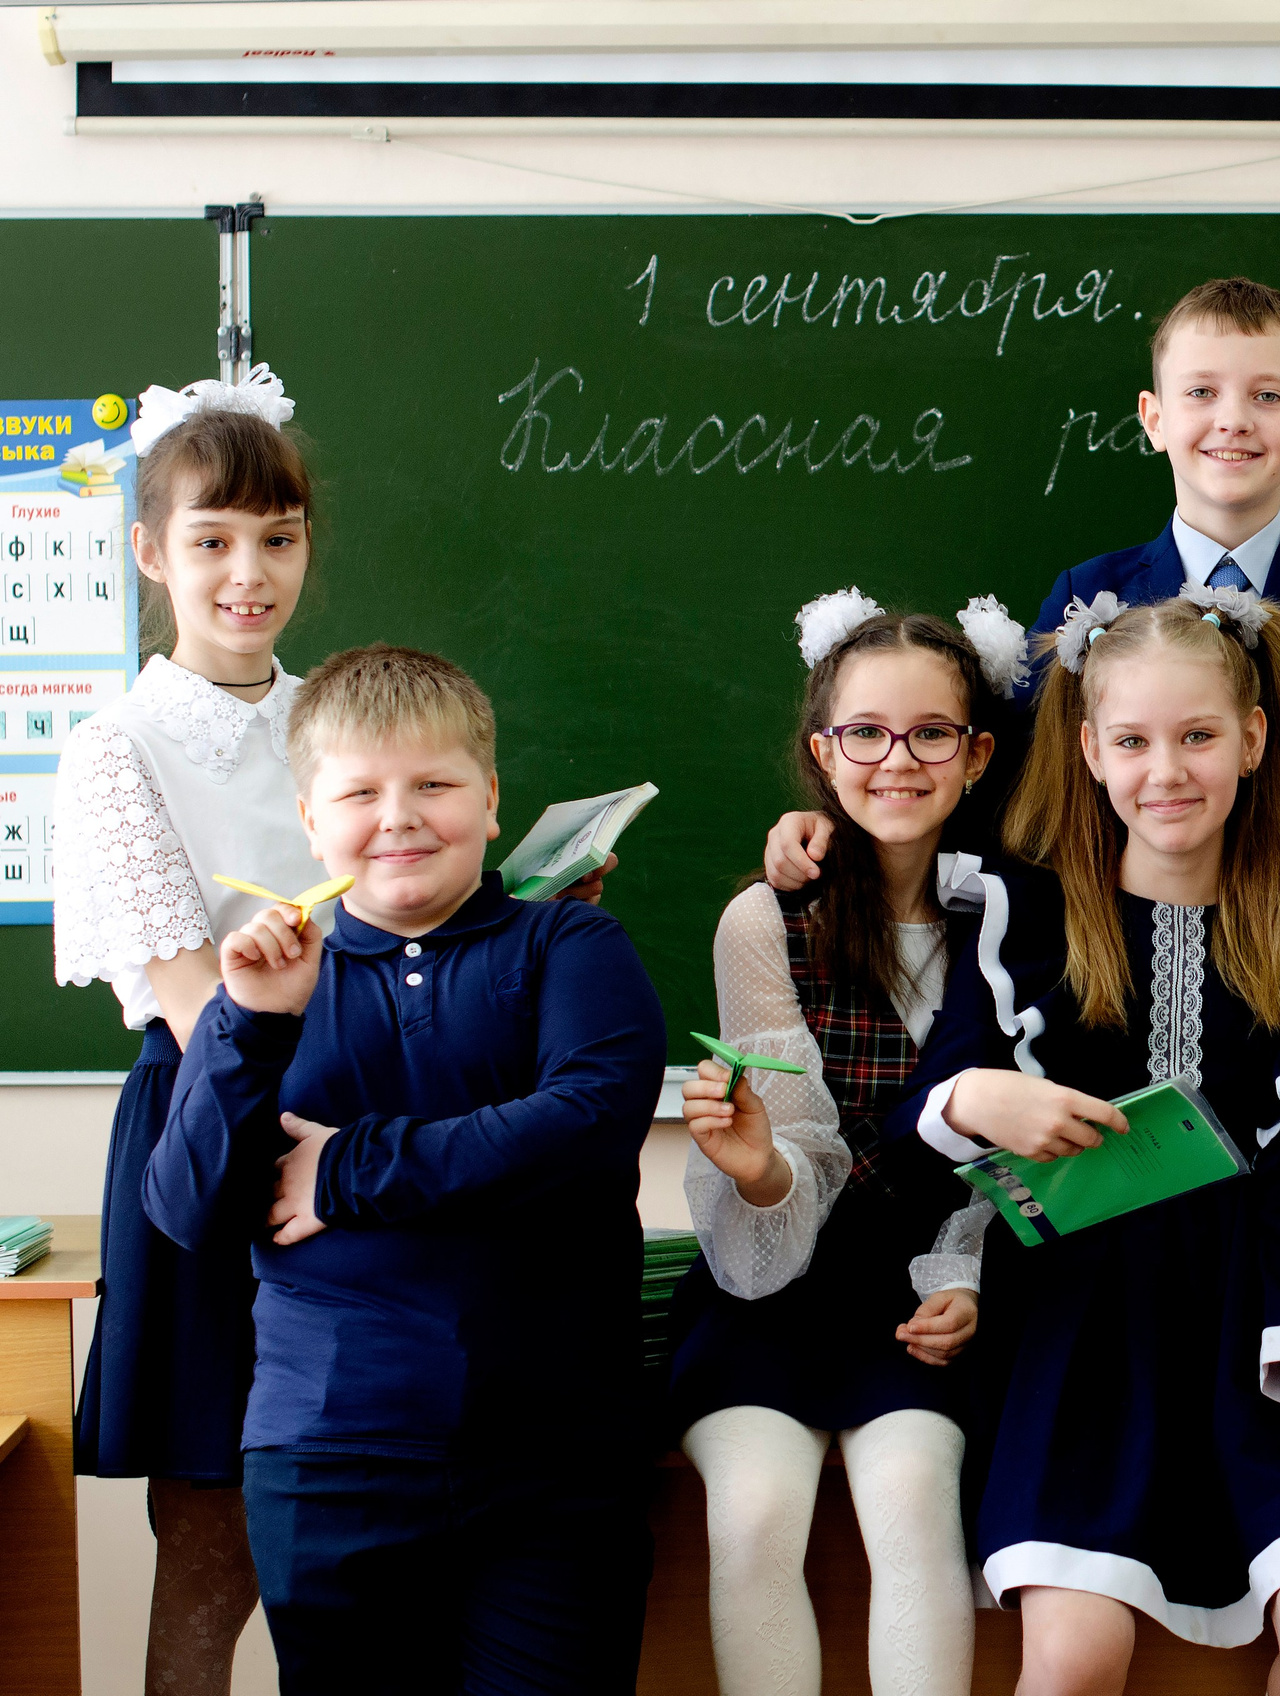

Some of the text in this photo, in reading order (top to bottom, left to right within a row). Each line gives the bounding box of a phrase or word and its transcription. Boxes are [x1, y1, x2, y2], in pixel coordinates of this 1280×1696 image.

[624, 252, 1142, 356] 1 сентября.
[0, 415, 72, 435] ВУКИ
[498, 357, 974, 475] Классная
[0, 444, 55, 461] ыка
[12, 504, 61, 521] Глухие
[0, 683, 93, 697] сегда мягкие
